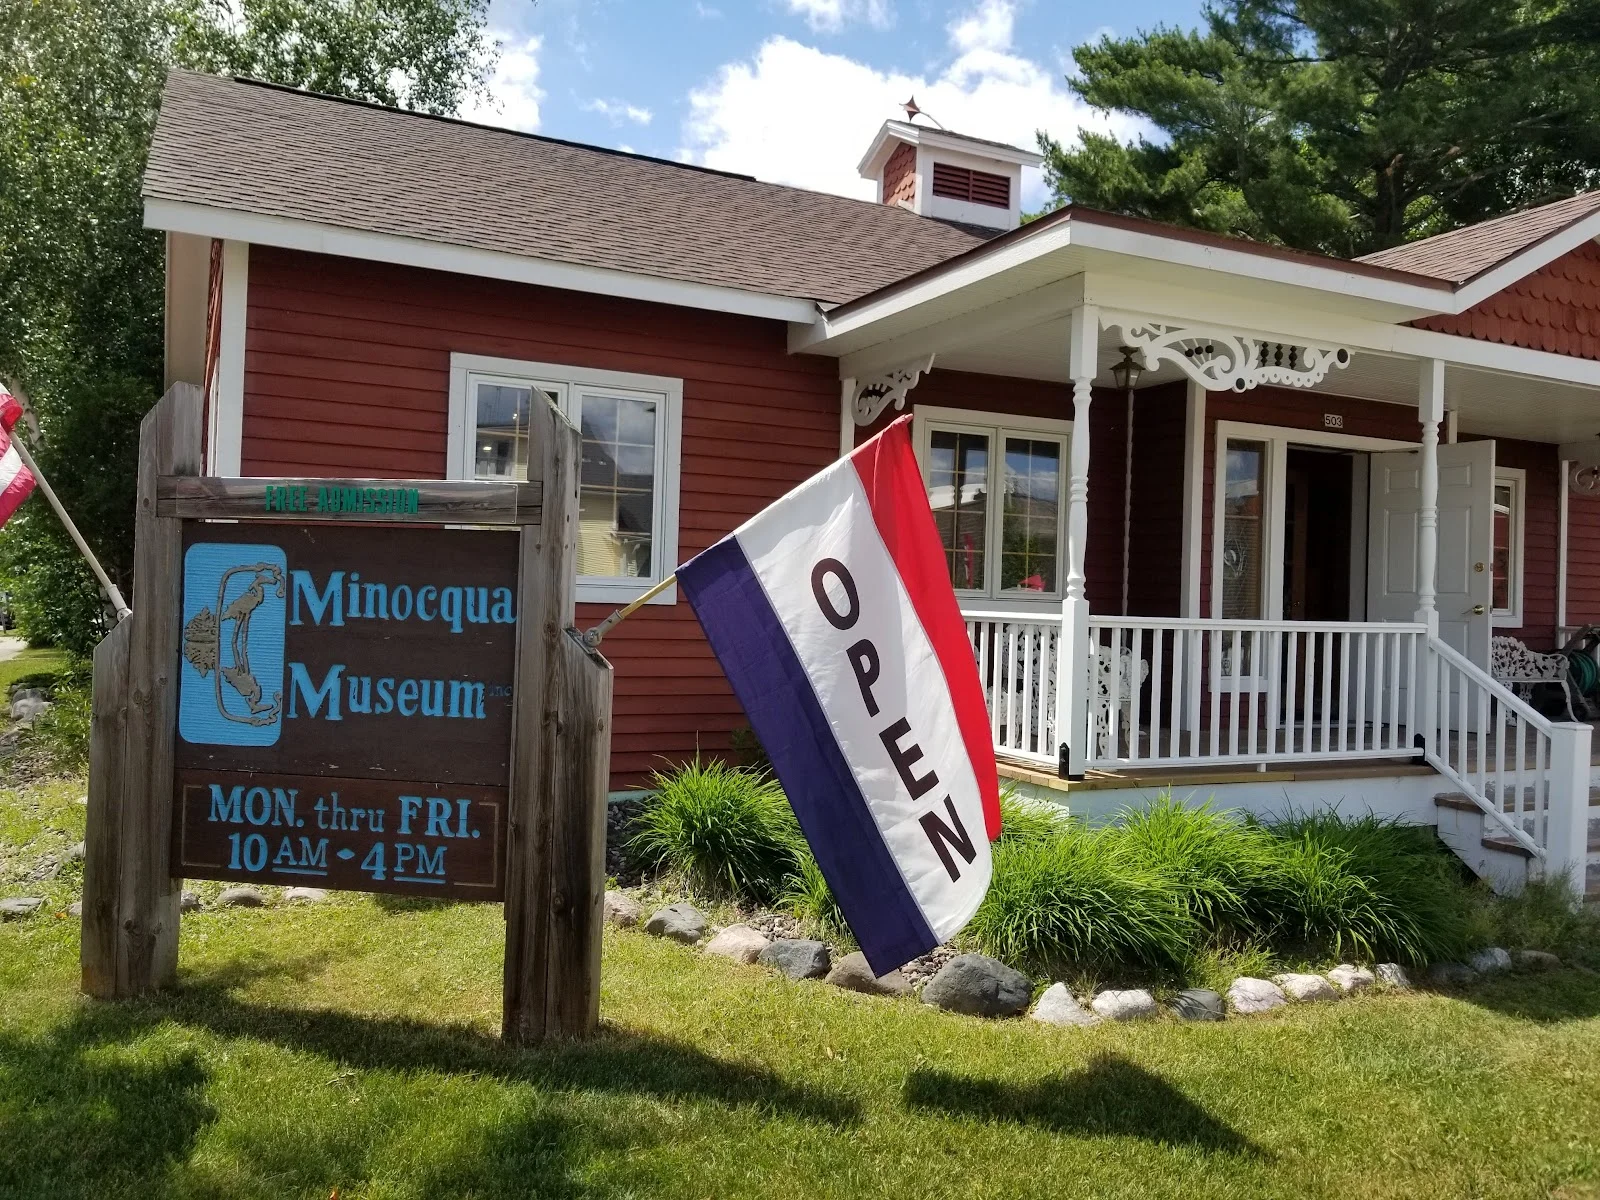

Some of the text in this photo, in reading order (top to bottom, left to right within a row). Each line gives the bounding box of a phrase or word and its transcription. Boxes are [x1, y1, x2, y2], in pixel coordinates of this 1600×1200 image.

[1325, 415, 1342, 426] 503
[266, 485, 420, 514] FREE ADMISSION
[289, 570, 517, 633] Minocqua
[287, 662, 487, 720] Museum
[810, 557, 977, 883] OPEN
[207, 784, 481, 839] MON. thru FRI.
[228, 832, 448, 881] 10 AM 4 PM
